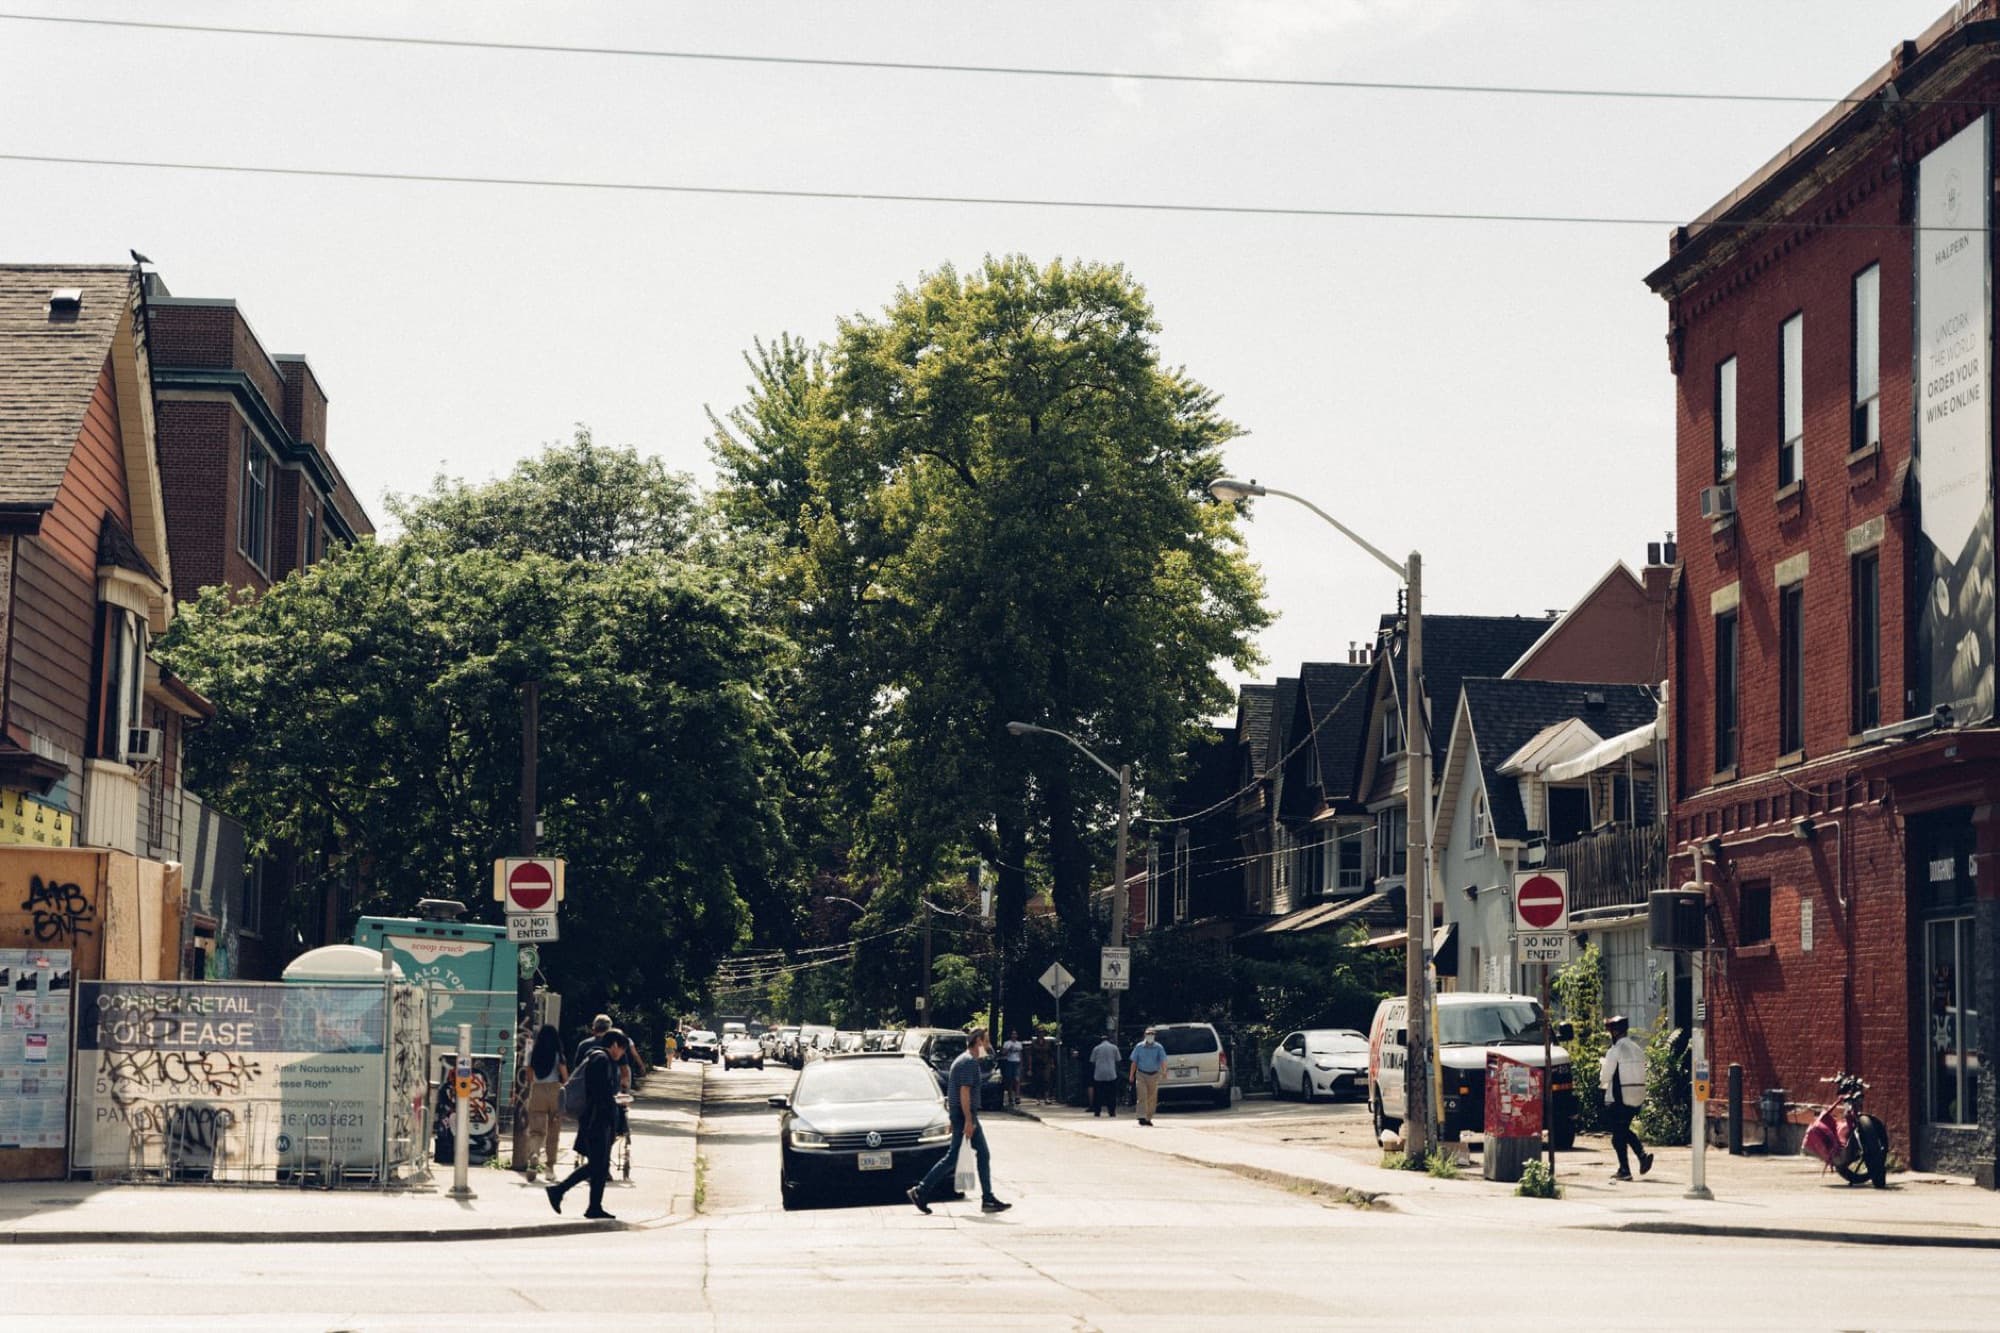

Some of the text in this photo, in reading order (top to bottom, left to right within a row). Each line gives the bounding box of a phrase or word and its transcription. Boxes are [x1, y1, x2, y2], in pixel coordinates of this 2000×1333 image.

[1935, 232, 1969, 265] HALPERN
[1935, 312, 1969, 344] UNCORK
[1929, 333, 1976, 370] THE WORLD
[1927, 359, 1979, 398] ORDER YOUR
[1926, 384, 1980, 424] WINE ONLINE
[513, 917, 549, 928] DO NOT
[517, 929, 548, 938] ENTER
[411, 943, 465, 953] scoop truck
[1523, 937, 1563, 947] DO NOT
[97, 995, 254, 1013] CORNER RETAIL
[96, 1021, 155, 1045] FOR
[164, 1022, 254, 1046] LEASE
[273, 1064, 297, 1073] Amir
[168, 1080, 182, 1095] &
[272, 1079, 302, 1088] Jesse
